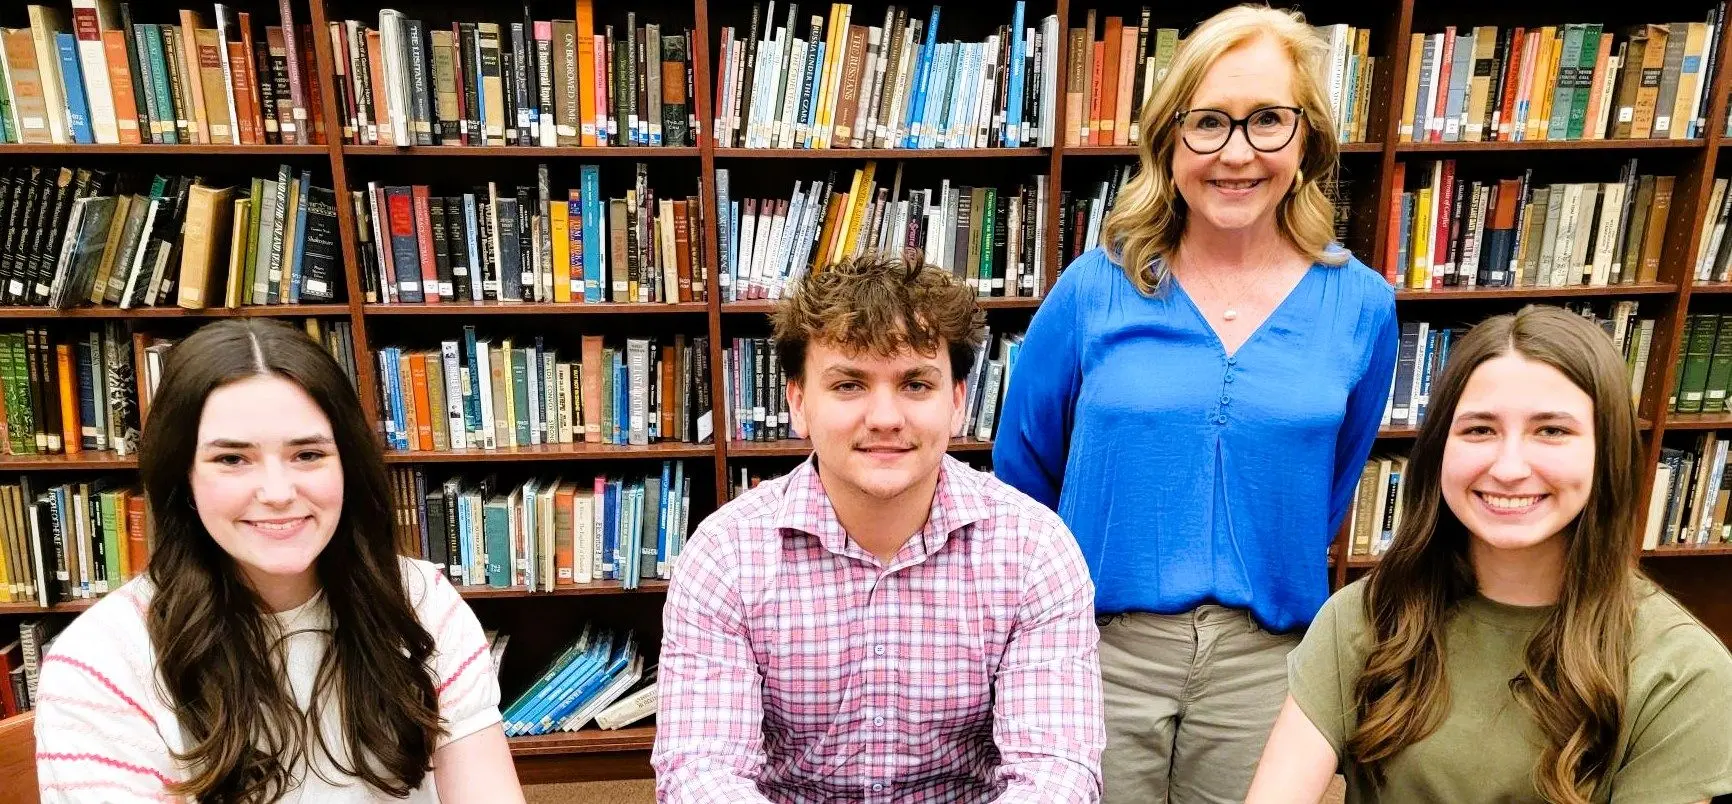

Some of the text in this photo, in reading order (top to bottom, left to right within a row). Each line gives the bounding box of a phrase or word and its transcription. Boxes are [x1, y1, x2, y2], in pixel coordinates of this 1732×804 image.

[538, 40, 548, 50] The
[810, 26, 820, 52] RUSSIA
[412, 46, 422, 92] LUSITANIA
[566, 34, 576, 122] ON BORROWED TIME
[806, 54, 816, 80] UNDER
[844, 34, 862, 100] THE RUSSIANS
[540, 86, 552, 106] Report
[800, 99, 810, 122] CZARS
[278, 172, 287, 192] LAND
[1444, 176, 1453, 199] Portraits
[277, 192, 286, 202] OF
[276, 203, 285, 220] THE
[416, 196, 426, 233] DEMOCRACY
[485, 204, 494, 235] WORLD
[1442, 206, 1450, 228] Conflict
[272, 222, 283, 250] INLAND
[420, 246, 428, 265] TRIAL
[634, 356, 642, 403] THE LAST GREAT
[49, 492, 58, 514] PEOPLE
[53, 532, 62, 546] NILE
[20, 629, 36, 671] WORLD
